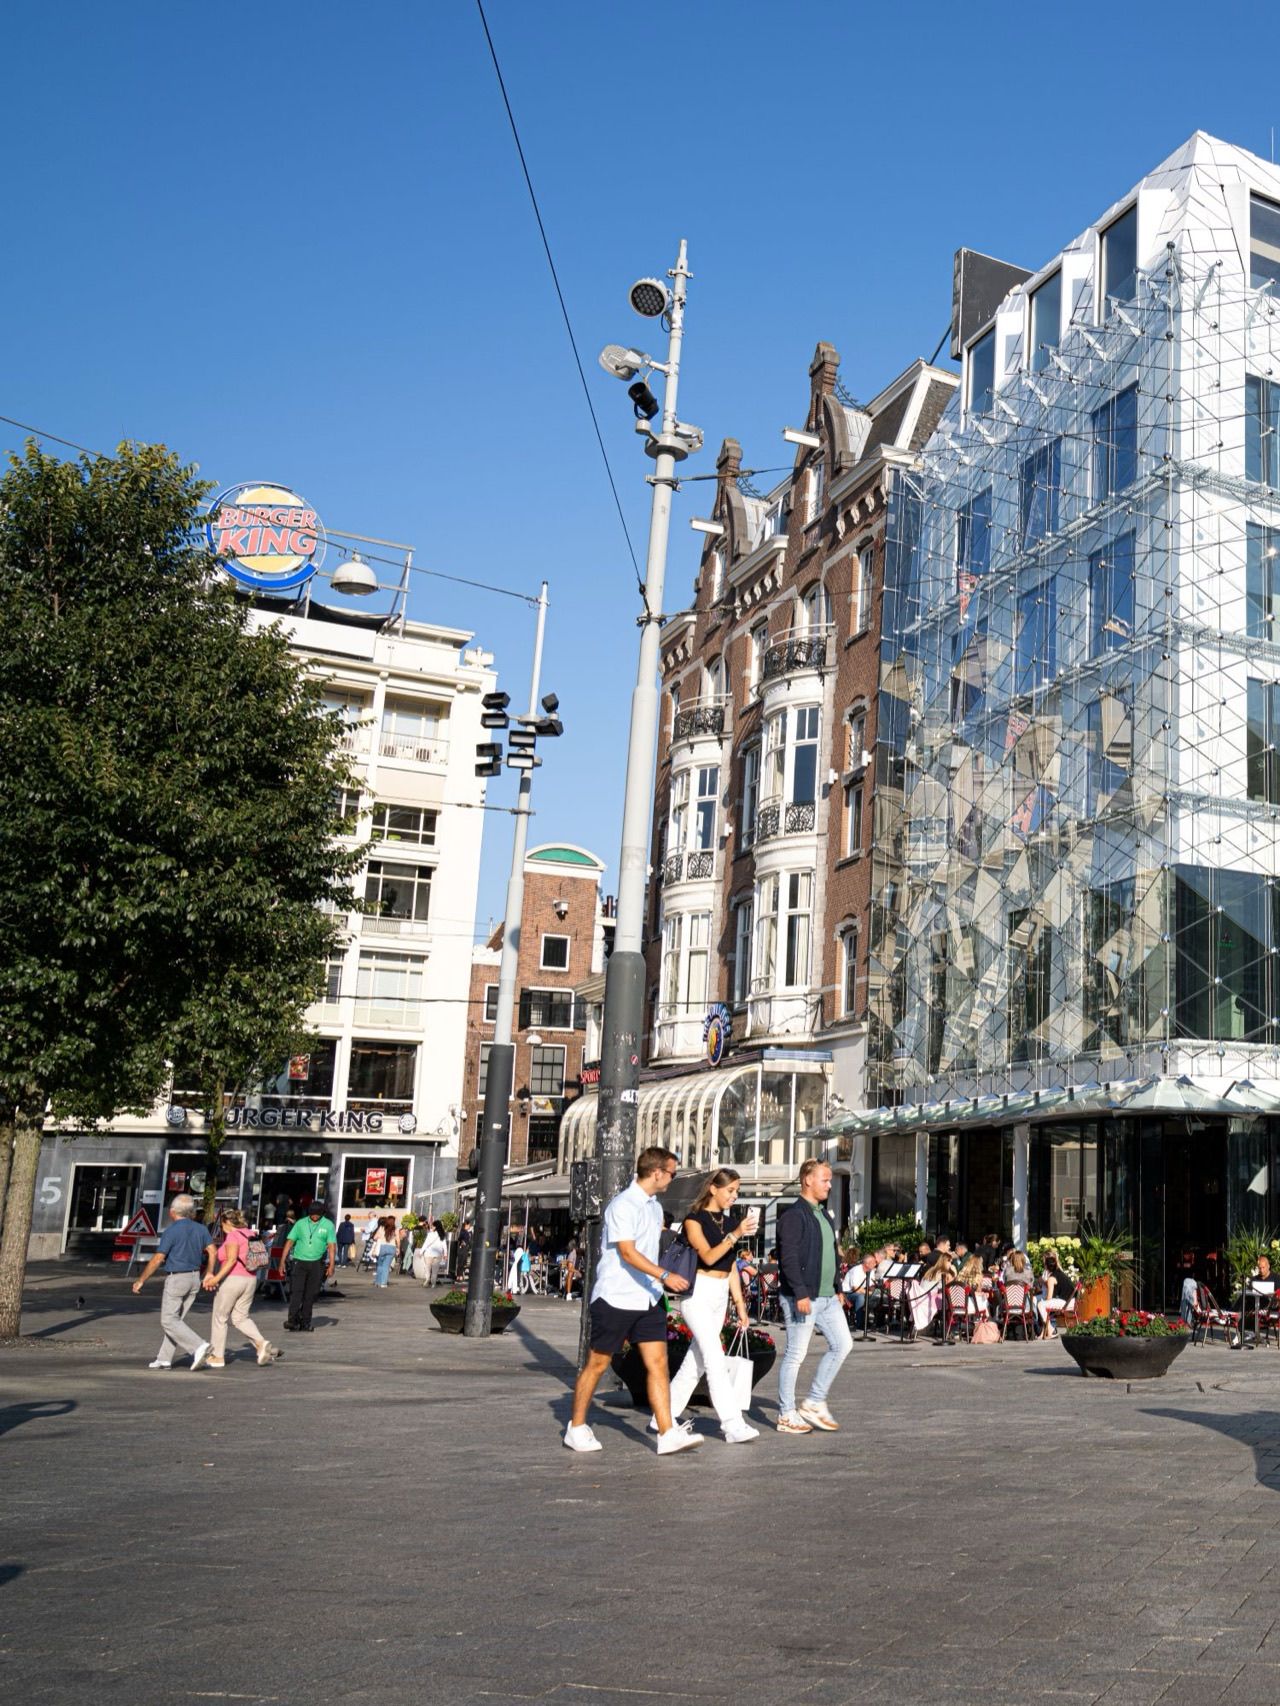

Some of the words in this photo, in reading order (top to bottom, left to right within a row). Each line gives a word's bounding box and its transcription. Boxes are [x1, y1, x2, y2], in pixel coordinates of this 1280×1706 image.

[217, 507, 316, 528] BURGER
[217, 527, 318, 555] KING
[205, 1107, 313, 1127] URGER
[320, 1109, 383, 1130] KING
[40, 1177, 61, 1204] 5
